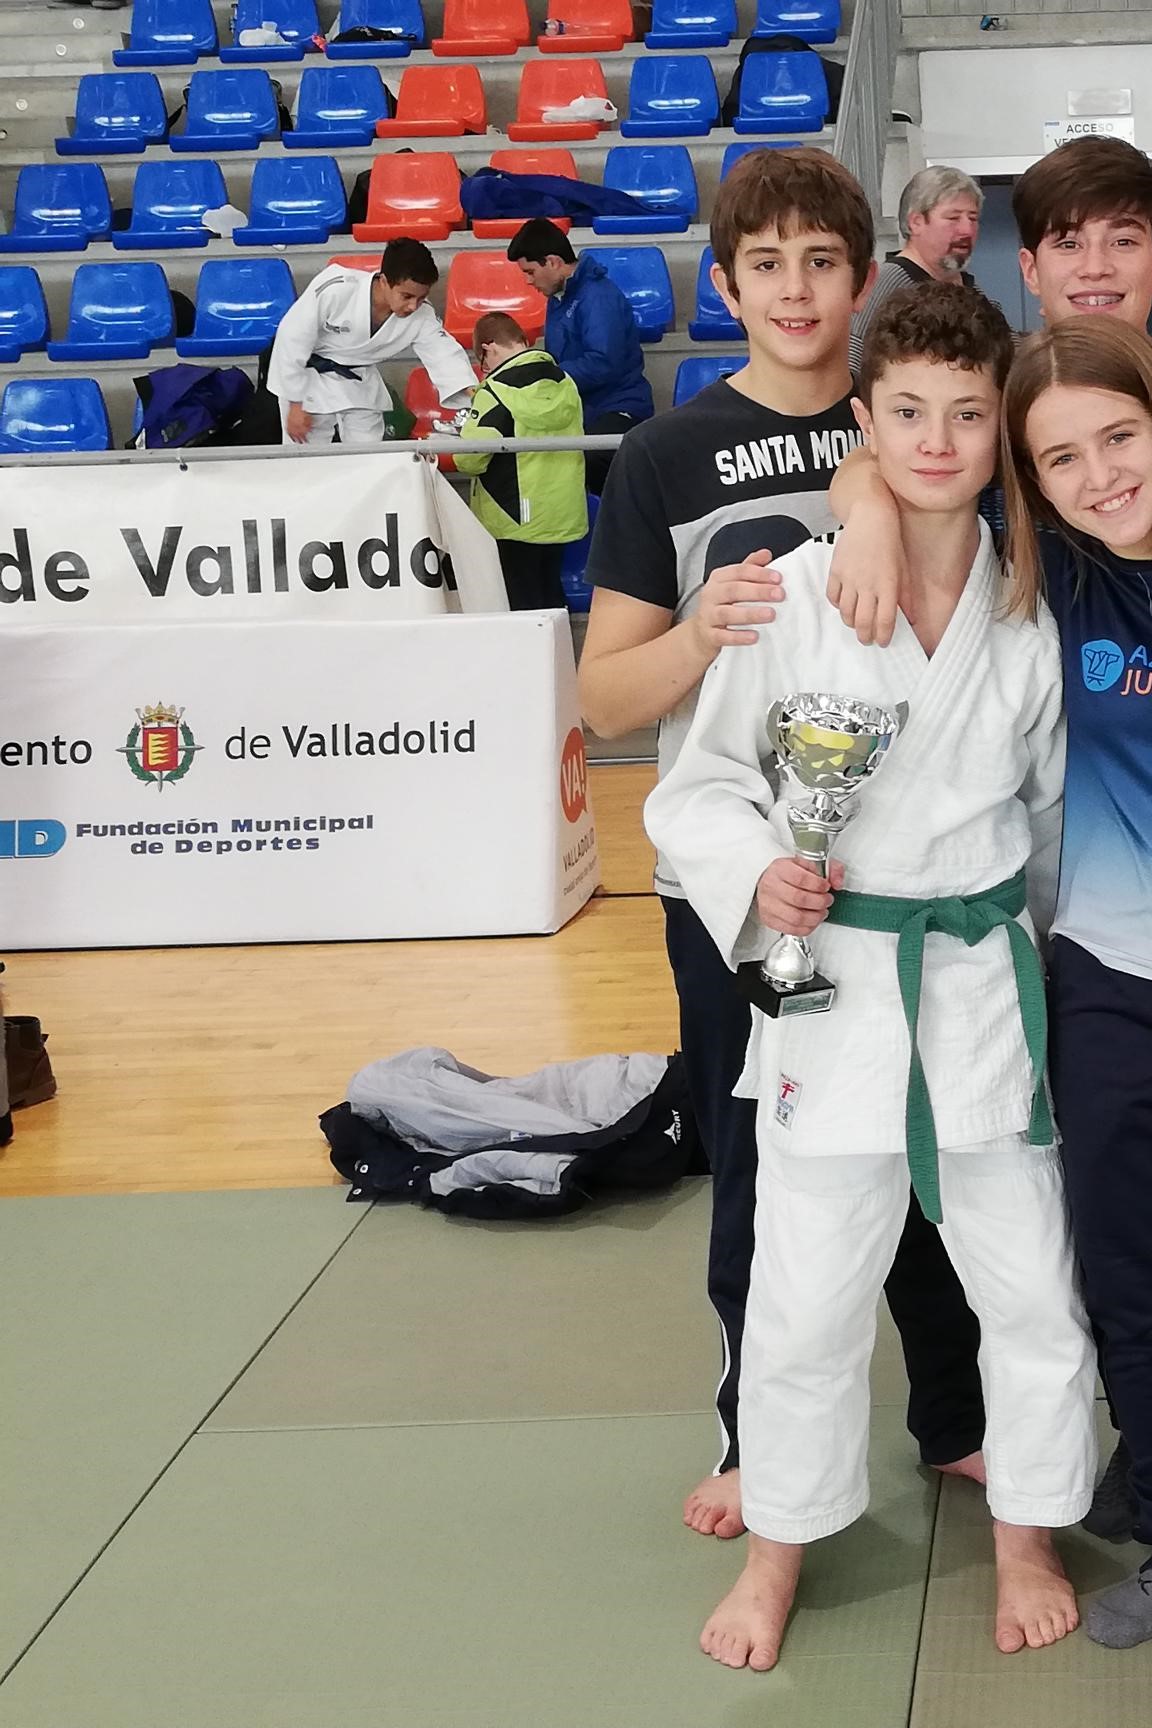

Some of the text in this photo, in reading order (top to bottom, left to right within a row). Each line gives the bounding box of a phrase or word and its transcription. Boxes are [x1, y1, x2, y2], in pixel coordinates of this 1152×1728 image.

[1066, 123, 1114, 133] ACCESO
[715, 434, 806, 485] SANTA
[0, 527, 91, 603] de
[0, 719, 475, 766] ento de Valladolid
[562, 748, 586, 807] VA!
[76, 817, 219, 838] Fundación
[231, 814, 374, 834] Municipal
[130, 836, 320, 855] de Deportes
